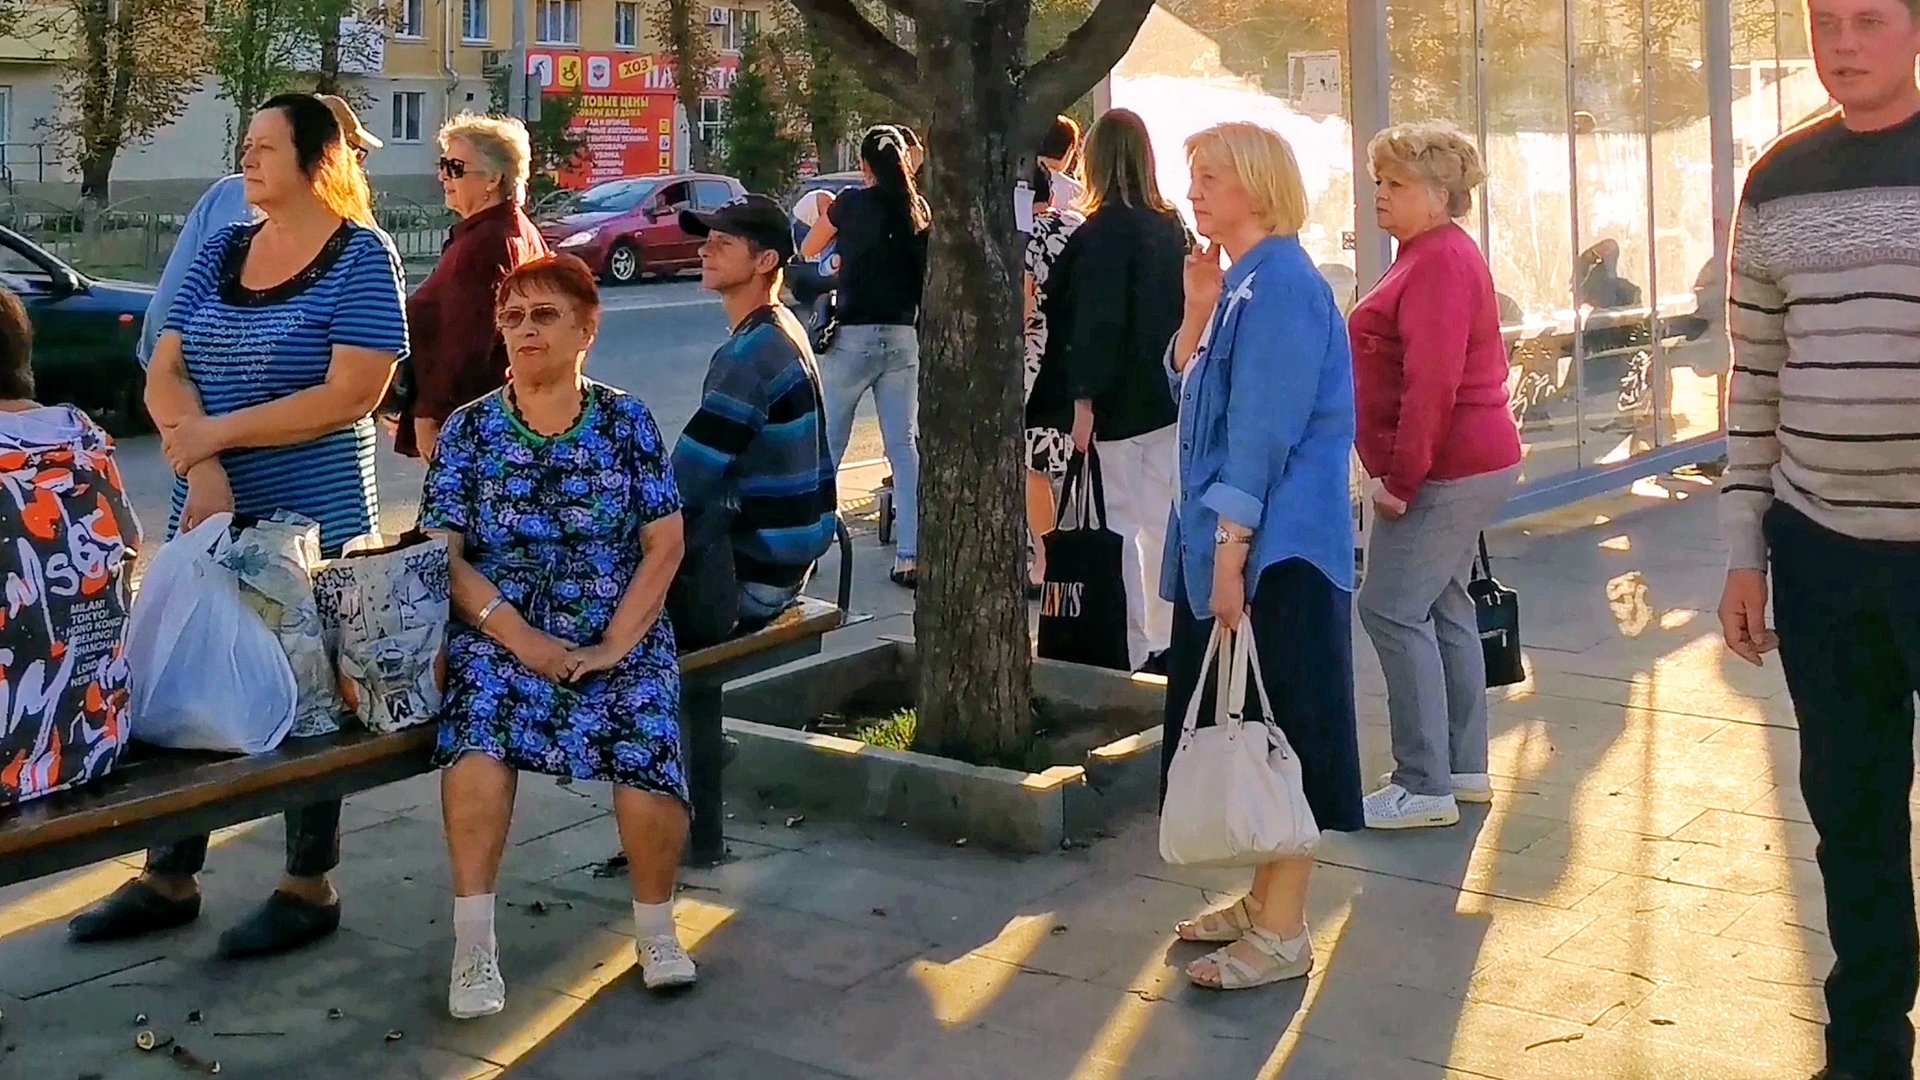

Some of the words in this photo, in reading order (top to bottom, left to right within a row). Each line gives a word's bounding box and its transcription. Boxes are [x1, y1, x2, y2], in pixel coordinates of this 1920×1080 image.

[623, 59, 649, 76] ХОЗ
[580, 95, 618, 107] ТОВЫЕ
[619, 95, 649, 109] ЦЕНЫ
[70, 609, 110, 625] TOKYO!
[66, 622, 92, 637] HONG
